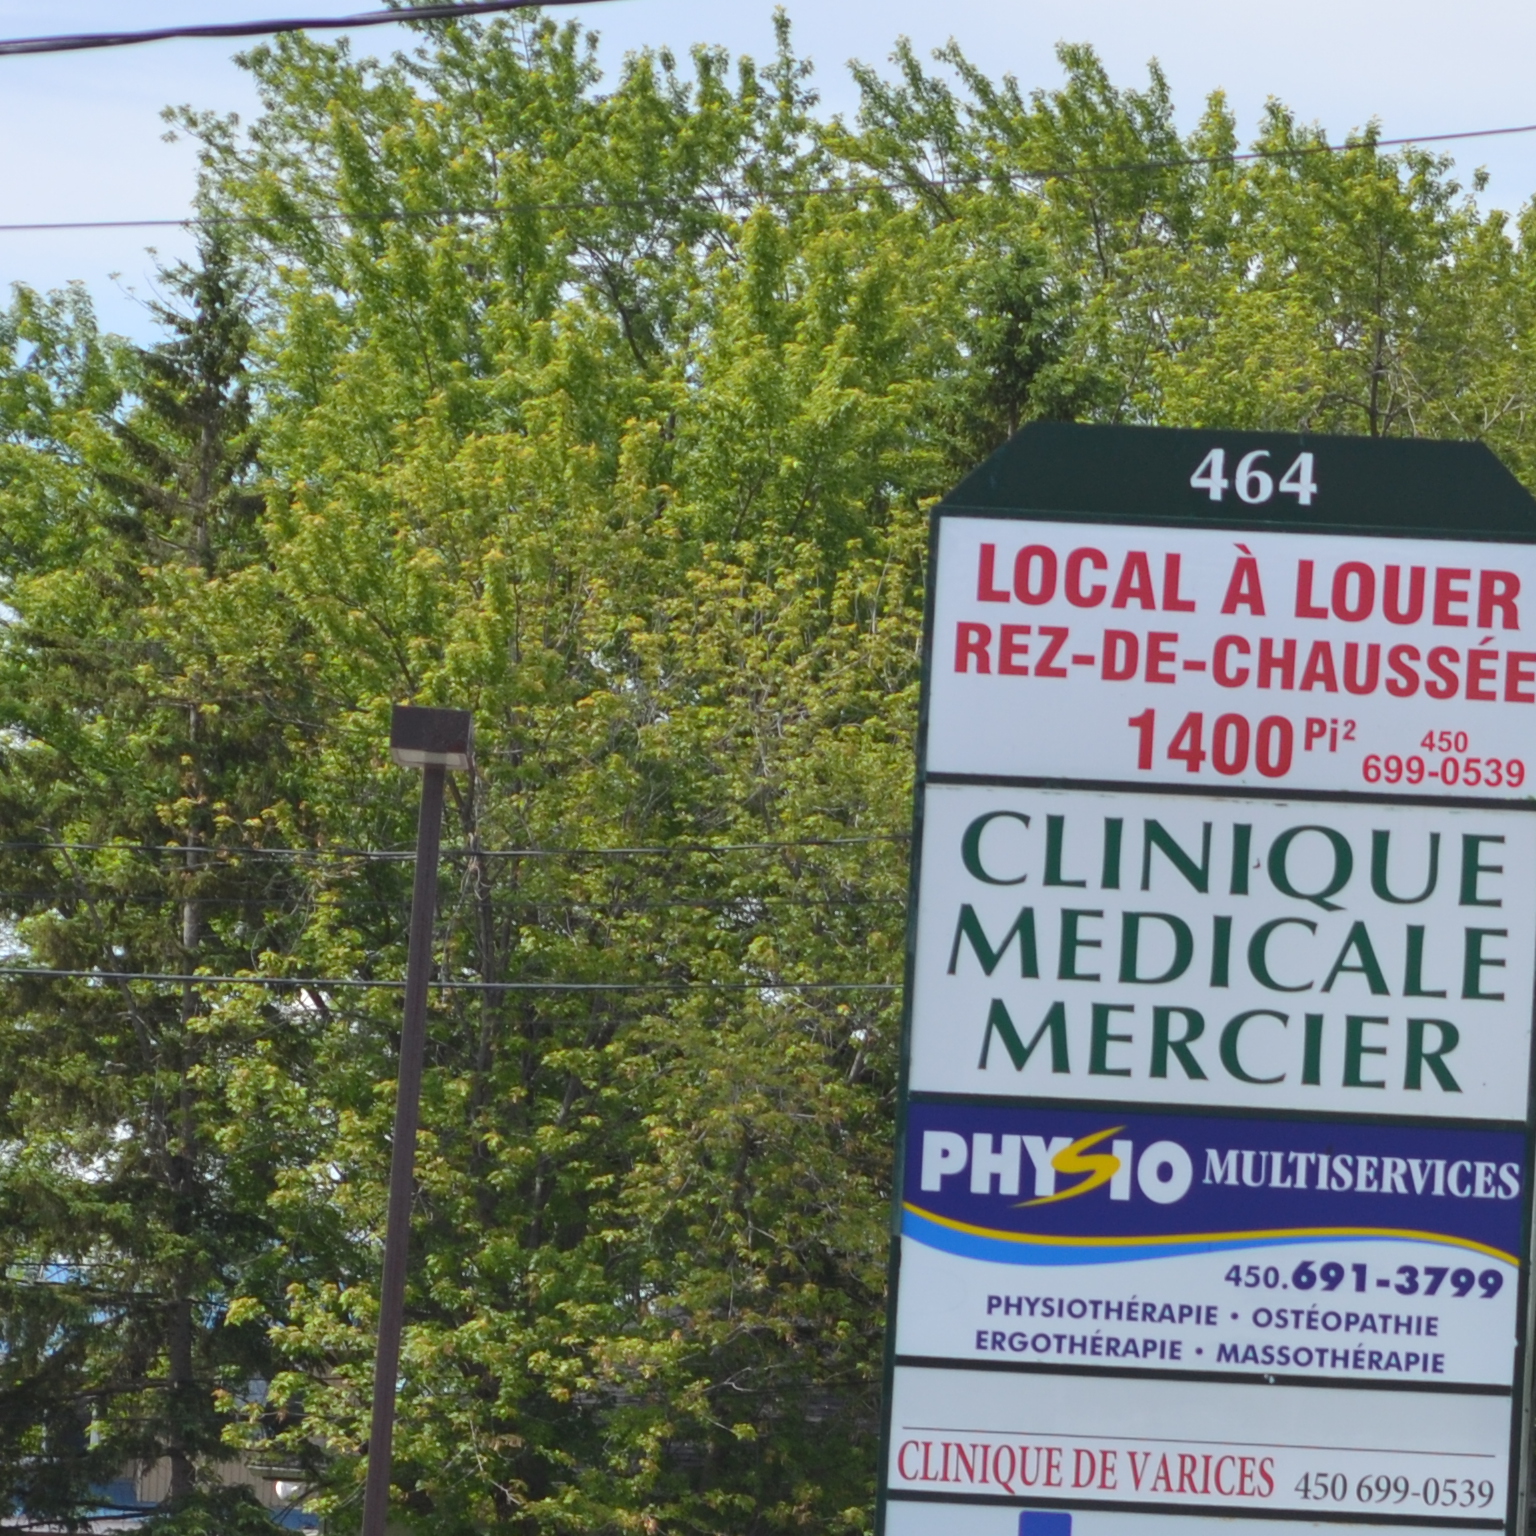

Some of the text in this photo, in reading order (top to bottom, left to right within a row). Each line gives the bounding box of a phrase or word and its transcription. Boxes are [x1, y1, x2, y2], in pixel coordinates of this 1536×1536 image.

[1190, 448, 1318, 506] 464
[976, 542, 1521, 631] LOCAL À LOUER
[1127, 707, 1294, 779] 1400
[1362, 753, 1526, 789] 699-0539
[1420, 729, 1469, 754] 450
[960, 810, 1506, 911] CLINIQUE
[946, 903, 1508, 1002] MEDICALE
[977, 998, 1463, 1093] MERCIER
[920, 1126, 1520, 1208] PHYSIO MULTISERVICES
[1223, 1260, 1504, 1300] 450.691-3799
[974, 1328, 1446, 1374] ERGOTHÉRAPIE MASSOTHÉRAPIE
[985, 1294, 1439, 1338] PHYSIOTHÉRAPIE OSTÉOPATHIE
[897, 1439, 1495, 1509] CLINIQUE DE VARICES 450 699-0539
